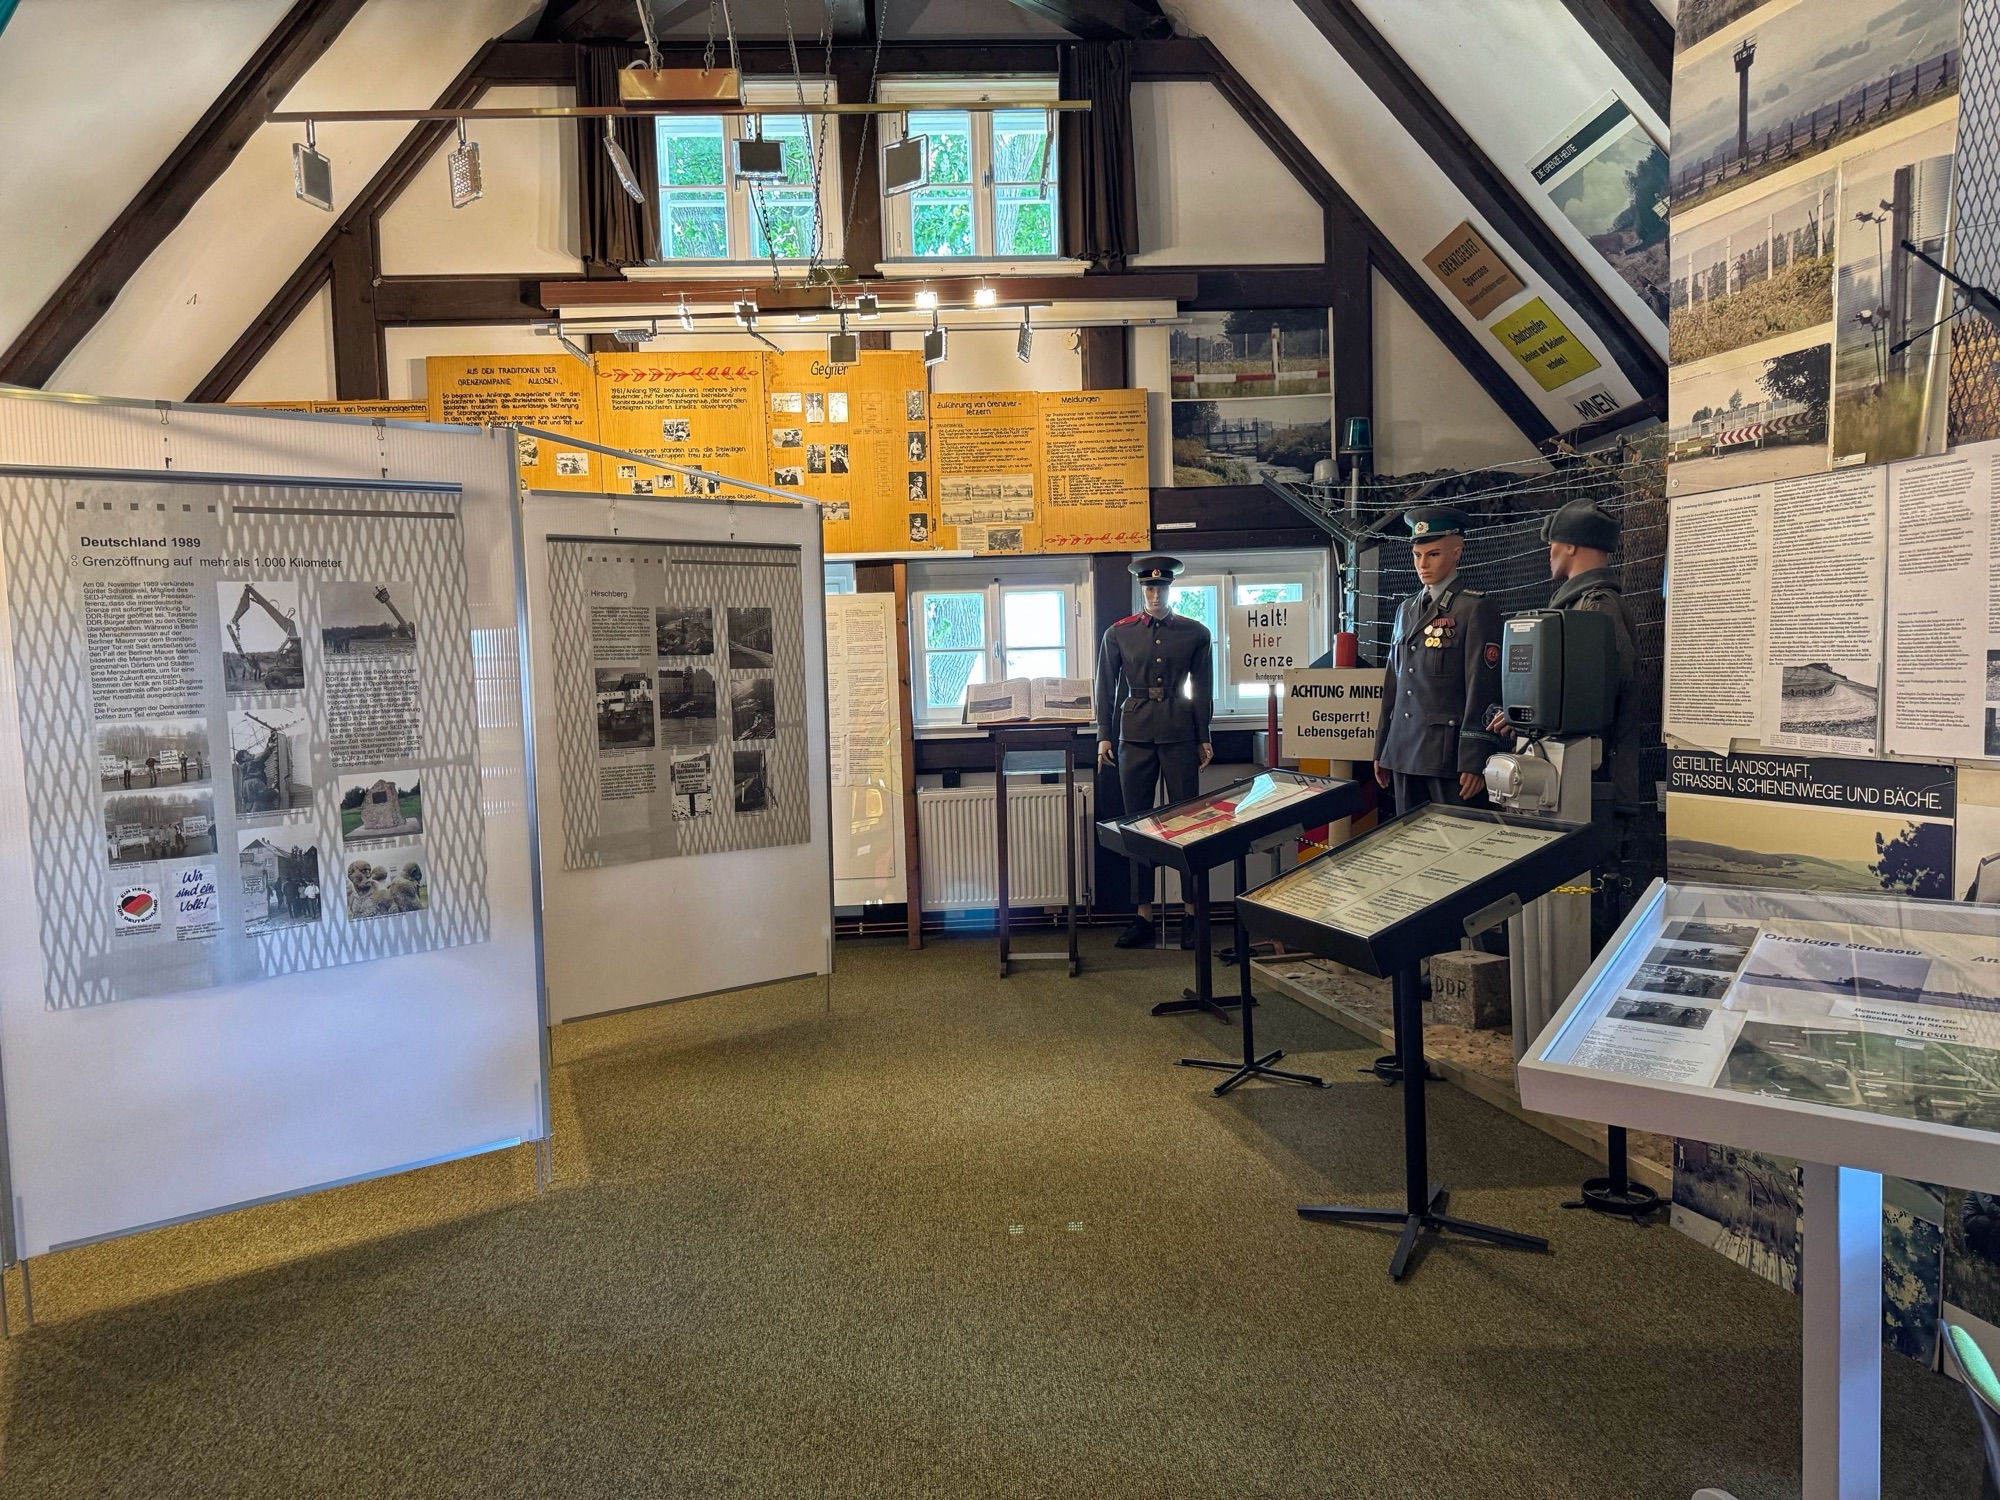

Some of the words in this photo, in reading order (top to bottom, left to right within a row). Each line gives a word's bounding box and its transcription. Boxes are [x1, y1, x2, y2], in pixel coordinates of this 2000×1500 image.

[1536, 169, 1546, 179] DIE
[1559, 144, 1577, 160] HEUTE
[1438, 238, 1480, 276] GRENZGEBIET
[1462, 265, 1489, 287] Sperrzone
[1507, 319, 1548, 346] Schutzstreifen
[1540, 342, 1549, 355] und
[1549, 334, 1568, 350] Befahren
[1546, 354, 1568, 370] verboten!
[811, 361, 848, 379] Gegner
[458, 378, 511, 386] GRENZKOMPANIE
[1061, 396, 1100, 404] Meldungen
[1573, 390, 1620, 420] MINEN
[357, 405, 427, 413] Postensignalgeräten
[80, 536, 167, 547] Deutschland
[171, 538, 201, 548] 1989
[82, 556, 169, 568] Grenzöffnung
[173, 557, 193, 566] auf
[200, 558, 230, 568] mehr
[233, 557, 250, 568] als
[254, 558, 286, 568] 1.000
[289, 558, 342, 568] Kilometer
[591, 590, 627, 598] Hirschberg
[1247, 608, 1287, 627] Halt!
[1252, 633, 1282, 648] Hier
[1243, 653, 1294, 668] Grenze
[1291, 685, 1344, 698] ACHTUNG
[1312, 710, 1370, 724] Gesperrt!
[1672, 755, 1722, 772] GETEILTE
[1725, 759, 1813, 781] LANDSCHAFT,
[1672, 773, 1734, 793] STRASSEN,
[1737, 778, 1843, 801] SCHIENENWEGE
[1846, 786, 1880, 804] UND
[1883, 787, 1942, 810] BÄCHE.
[182, 869, 203, 884] Wir
[120, 888, 131, 898] EIN
[175, 883, 200, 898] sind
[200, 883, 215, 894] ein
[124, 899, 158, 923] DEUTSCHLAND
[180, 897, 210, 912] Volk!
[1764, 933, 1840, 948] Ortslage
[1845, 938, 1922, 956] Stresow
[1435, 974, 1467, 998] DDR
[1906, 1028, 1959, 1040] Stresow
